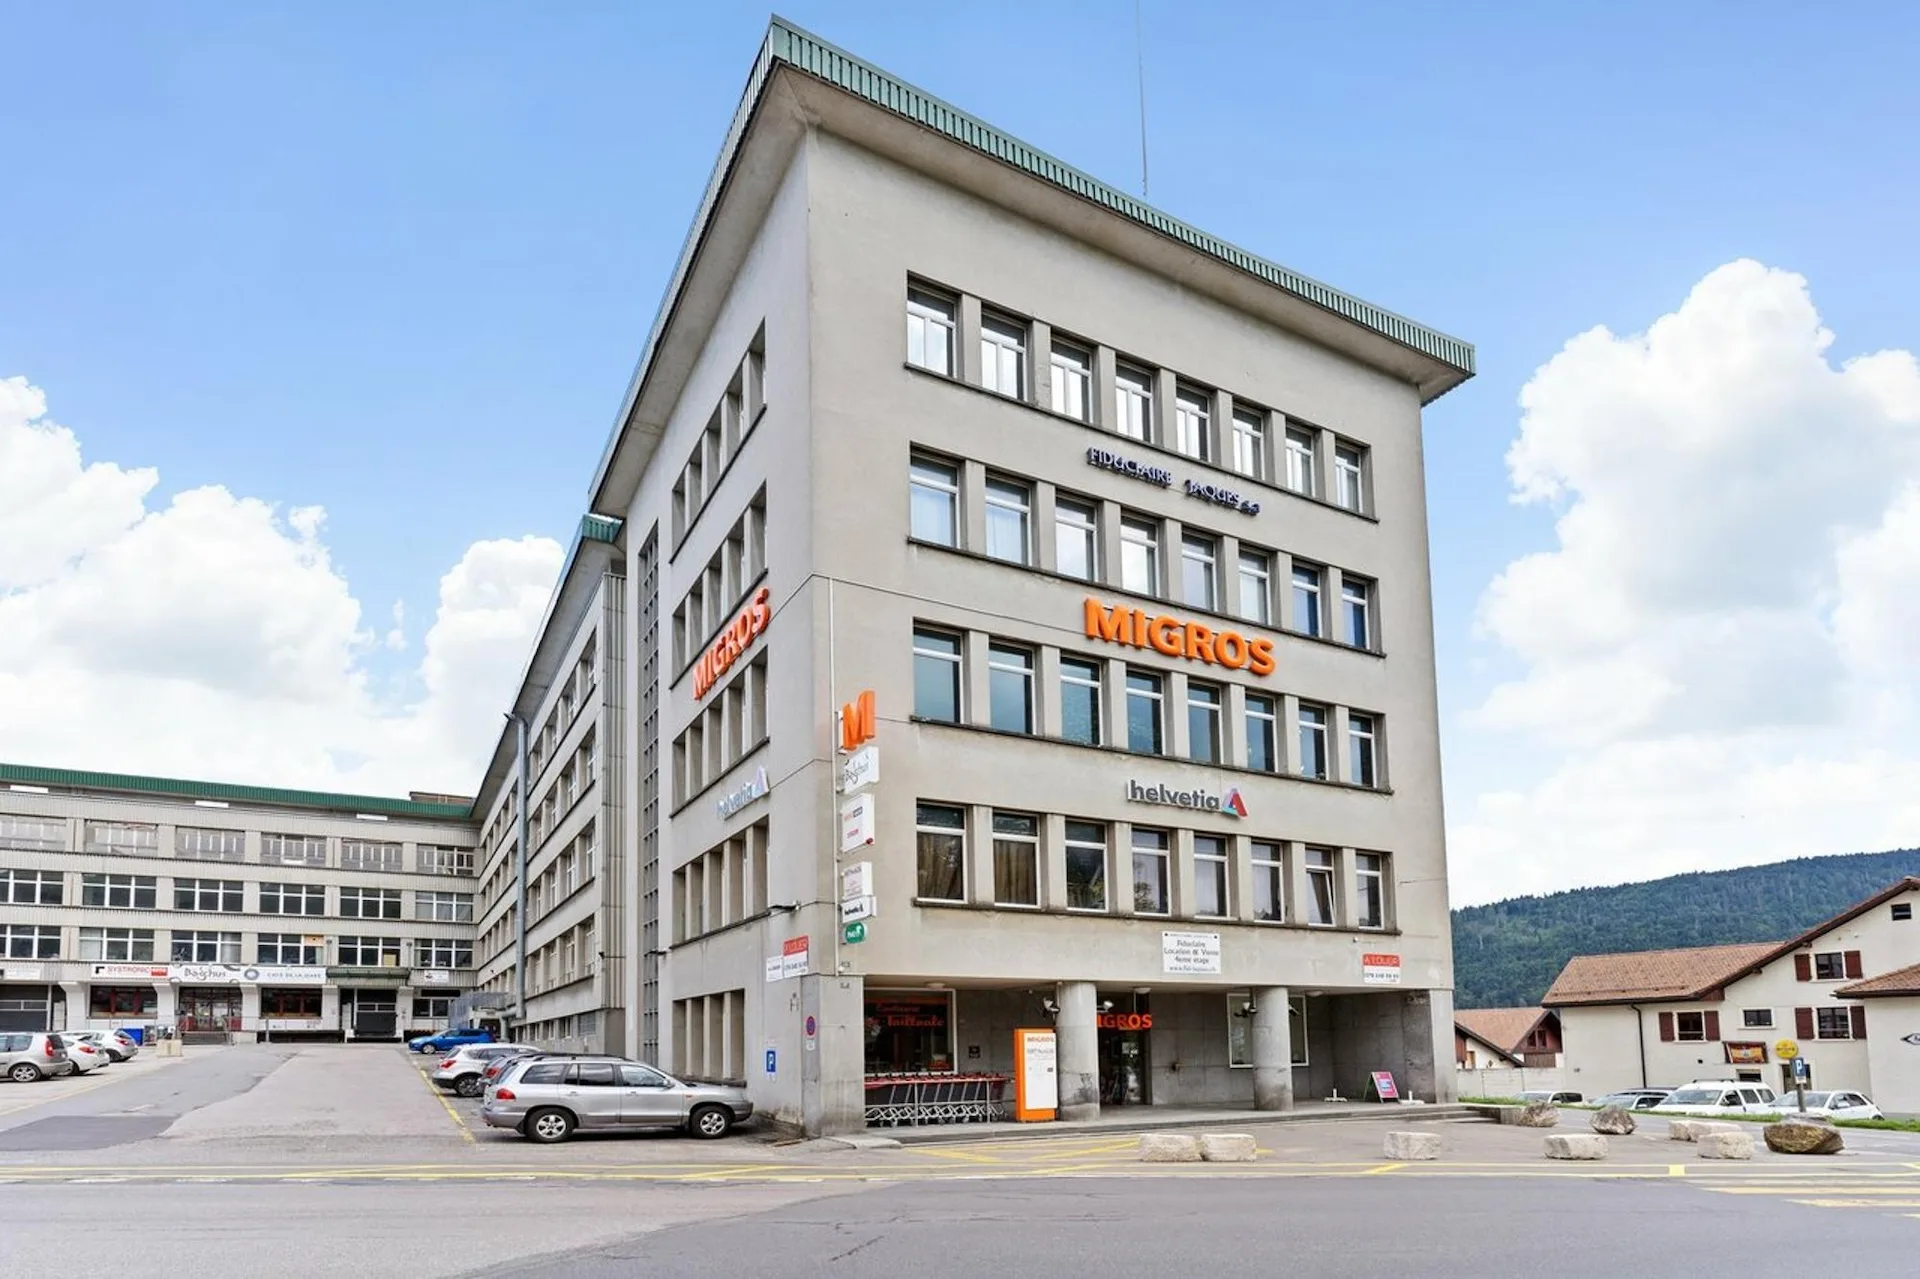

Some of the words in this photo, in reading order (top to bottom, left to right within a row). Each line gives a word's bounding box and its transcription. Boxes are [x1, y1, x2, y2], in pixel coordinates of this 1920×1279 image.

[1088, 447, 1172, 489] FIDUCIAIRE
[693, 586, 771, 700] MIGROS
[1085, 597, 1276, 676] MIGROS
[842, 688, 876, 752] M
[1127, 779, 1220, 810] helvetia
[1096, 1013, 1152, 1029] IGROS
[1795, 1059, 1804, 1074] P
